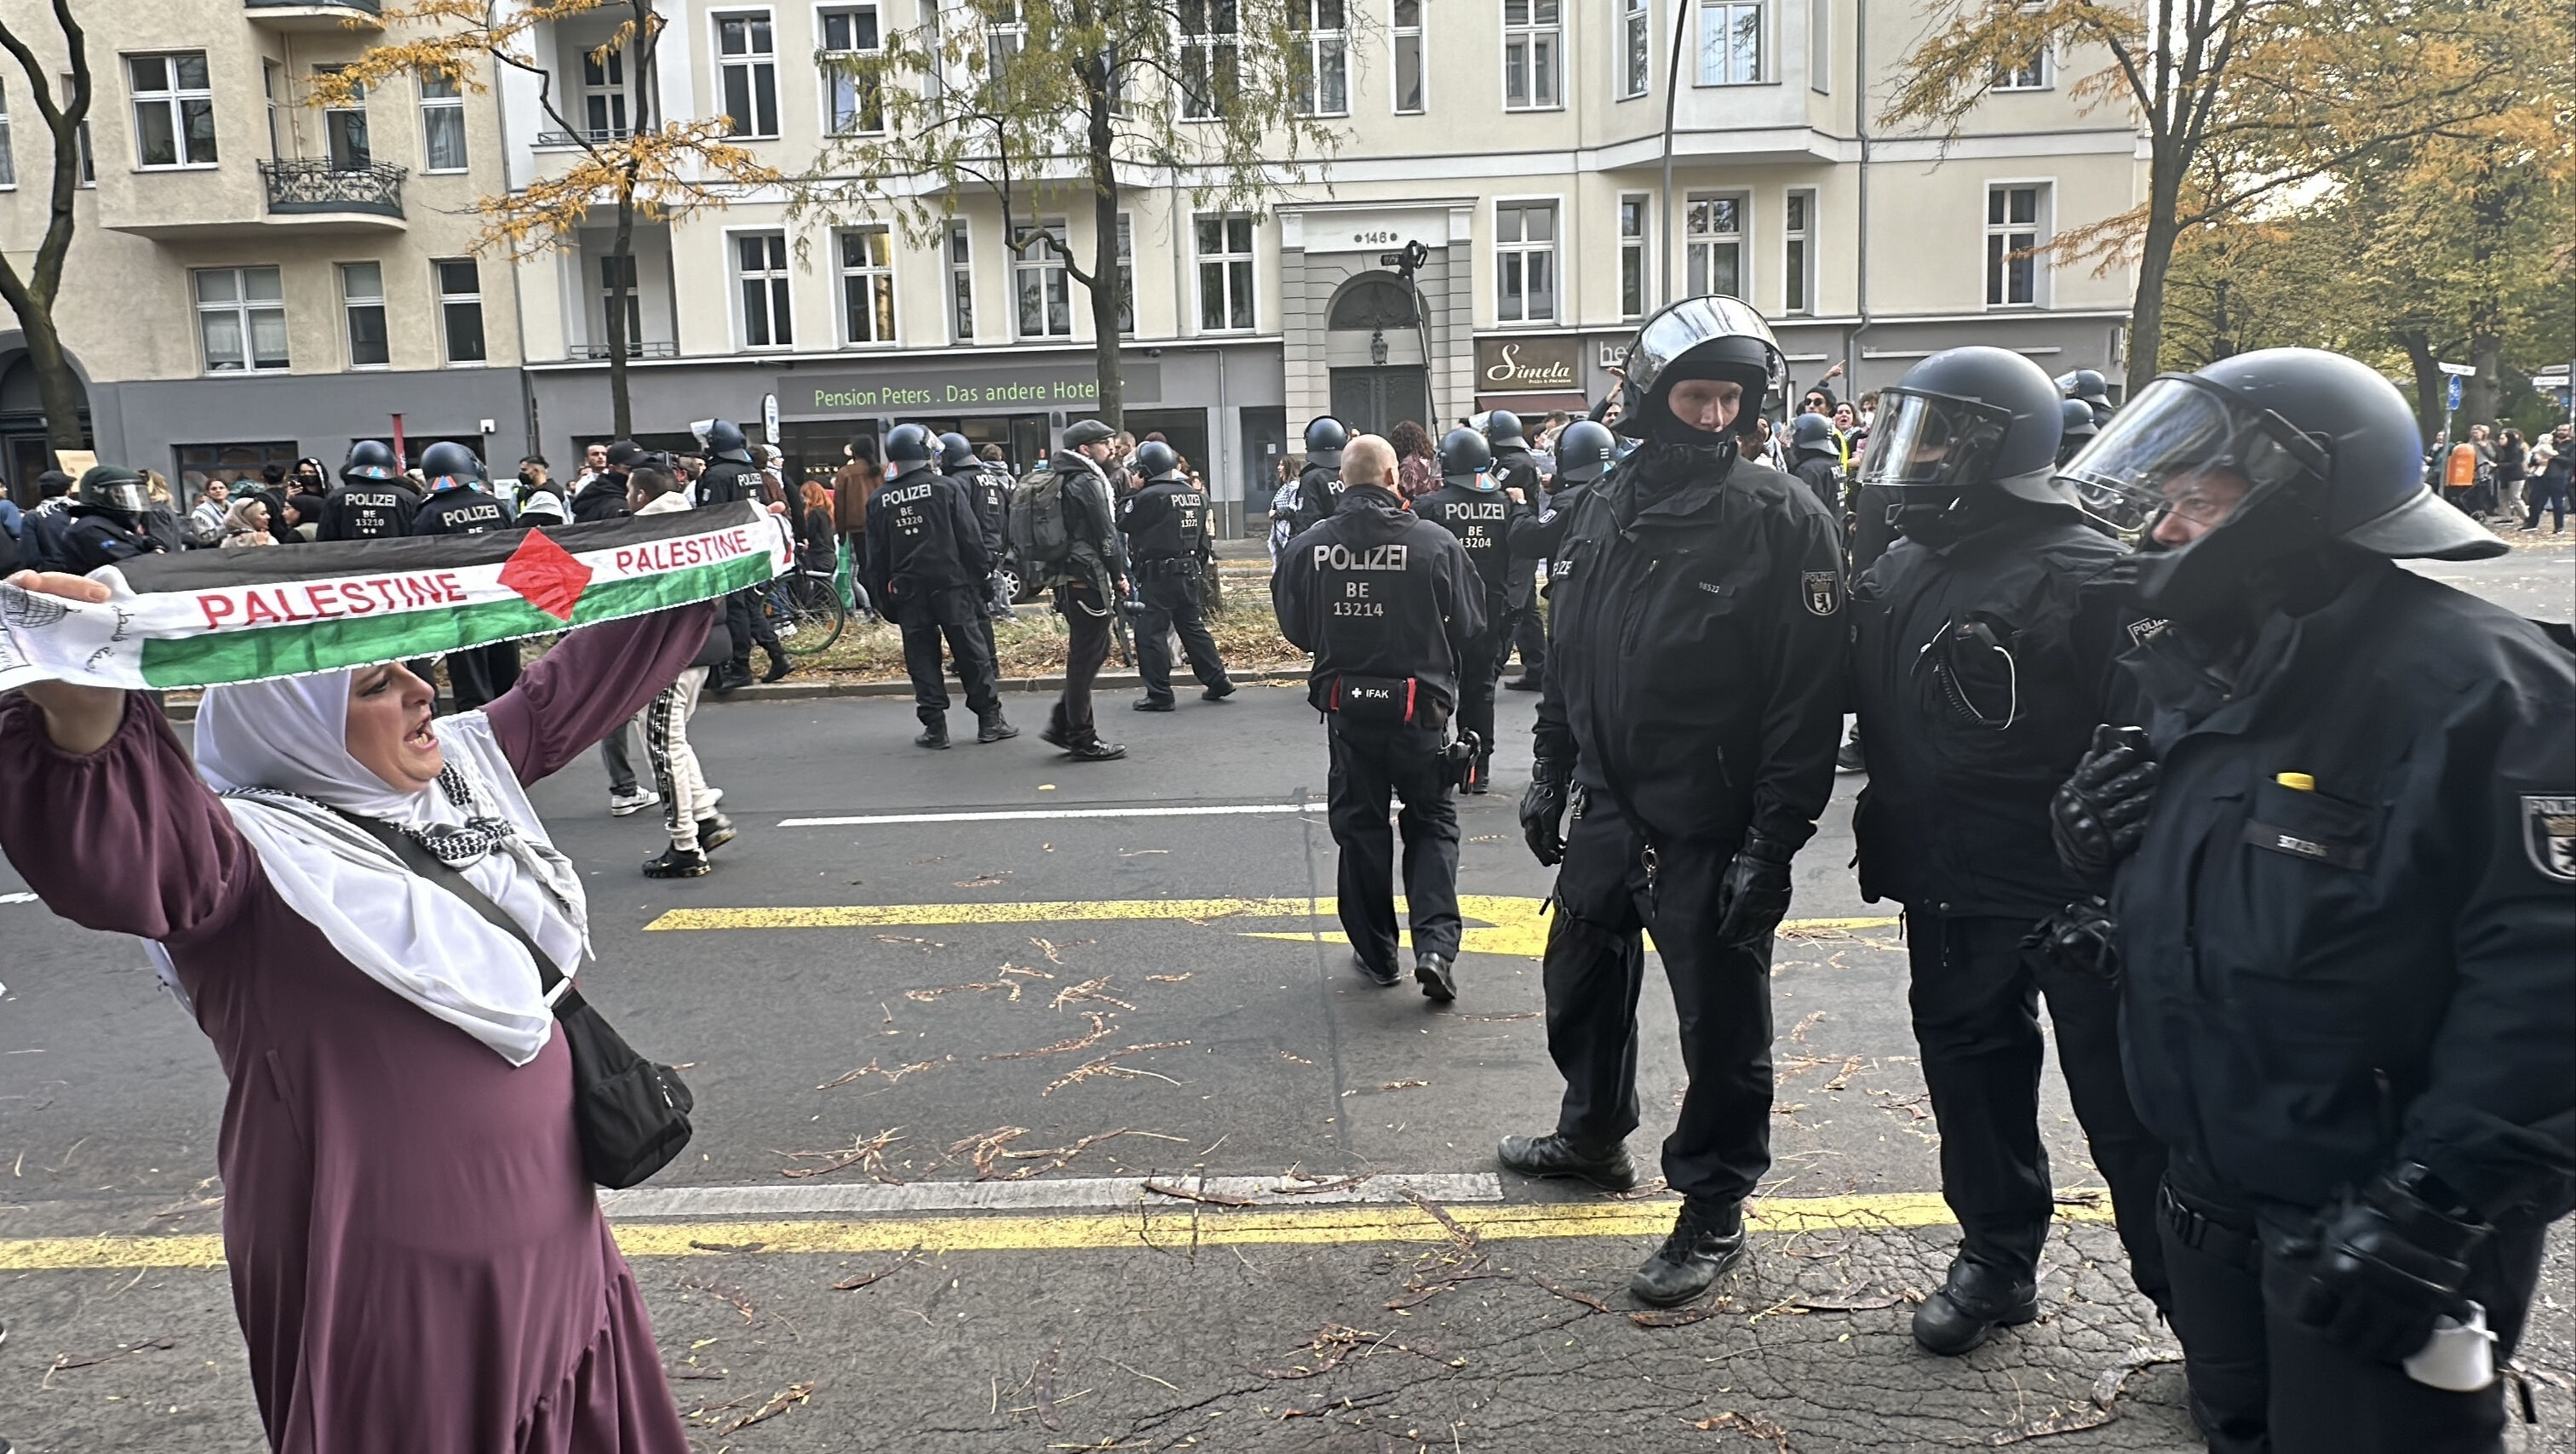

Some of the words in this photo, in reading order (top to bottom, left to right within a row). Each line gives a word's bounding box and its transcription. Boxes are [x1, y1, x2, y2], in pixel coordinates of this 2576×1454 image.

[1364, 232, 1386, 243] 146
[1487, 343, 1570, 381] Simela
[815, 389, 876, 407] Pension
[882, 386, 931, 404] Peters
[946, 385, 978, 403] Das
[986, 382, 1046, 401] andere
[1053, 379, 1099, 399] Hotel
[345, 493, 397, 507] POLIZEI
[881, 484, 932, 507] POLIZEI
[442, 505, 500, 527] POLIZEI
[900, 507, 914, 516] BE
[1445, 502, 1505, 520] POLIZEI
[896, 515, 923, 527] 13220
[1468, 526, 1483, 536] BE
[1459, 537, 1491, 547] 13204
[617, 529, 752, 575] PALESTINE
[1314, 543, 1408, 571] POLIZEI
[1346, 581, 1369, 598] BE
[195, 572, 468, 630] PALESTINE
[1334, 602, 1384, 616] 13214
[1366, 689, 1389, 698] IFAK
